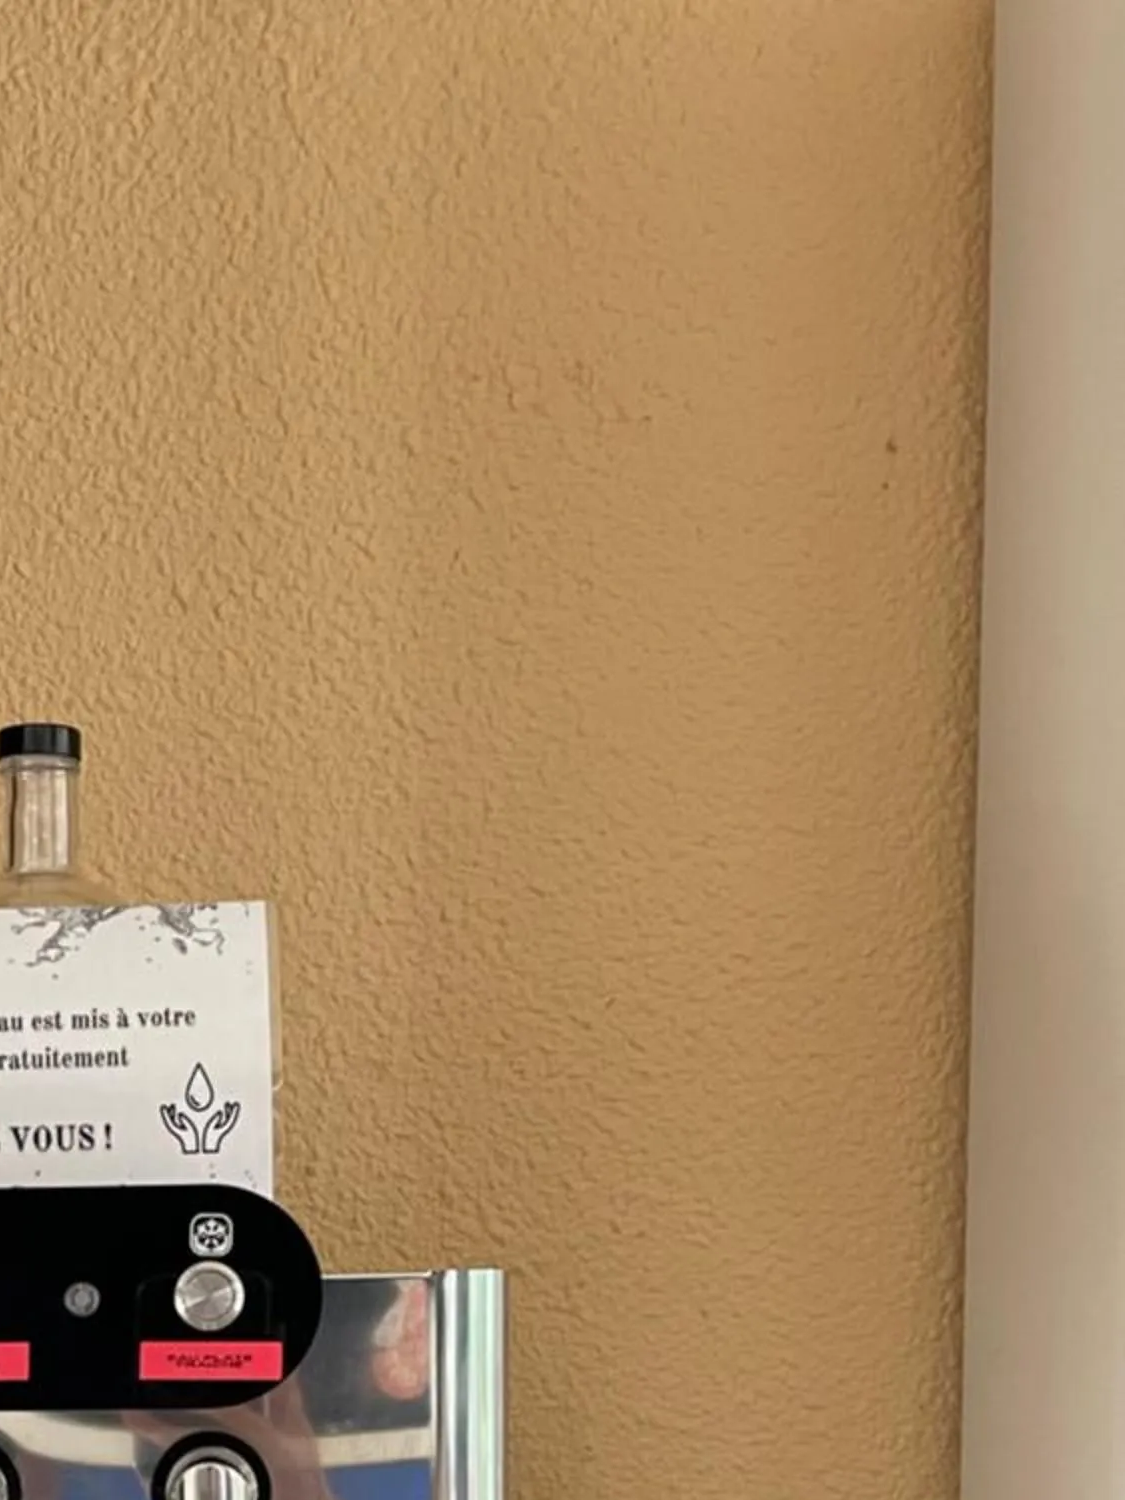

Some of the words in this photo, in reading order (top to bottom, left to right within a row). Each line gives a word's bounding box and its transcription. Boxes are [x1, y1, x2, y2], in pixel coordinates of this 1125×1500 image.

[31, 1011, 62, 1031] est
[71, 1008, 110, 1029] mis
[116, 1007, 129, 1028] à
[137, 1007, 196, 1027] votre
